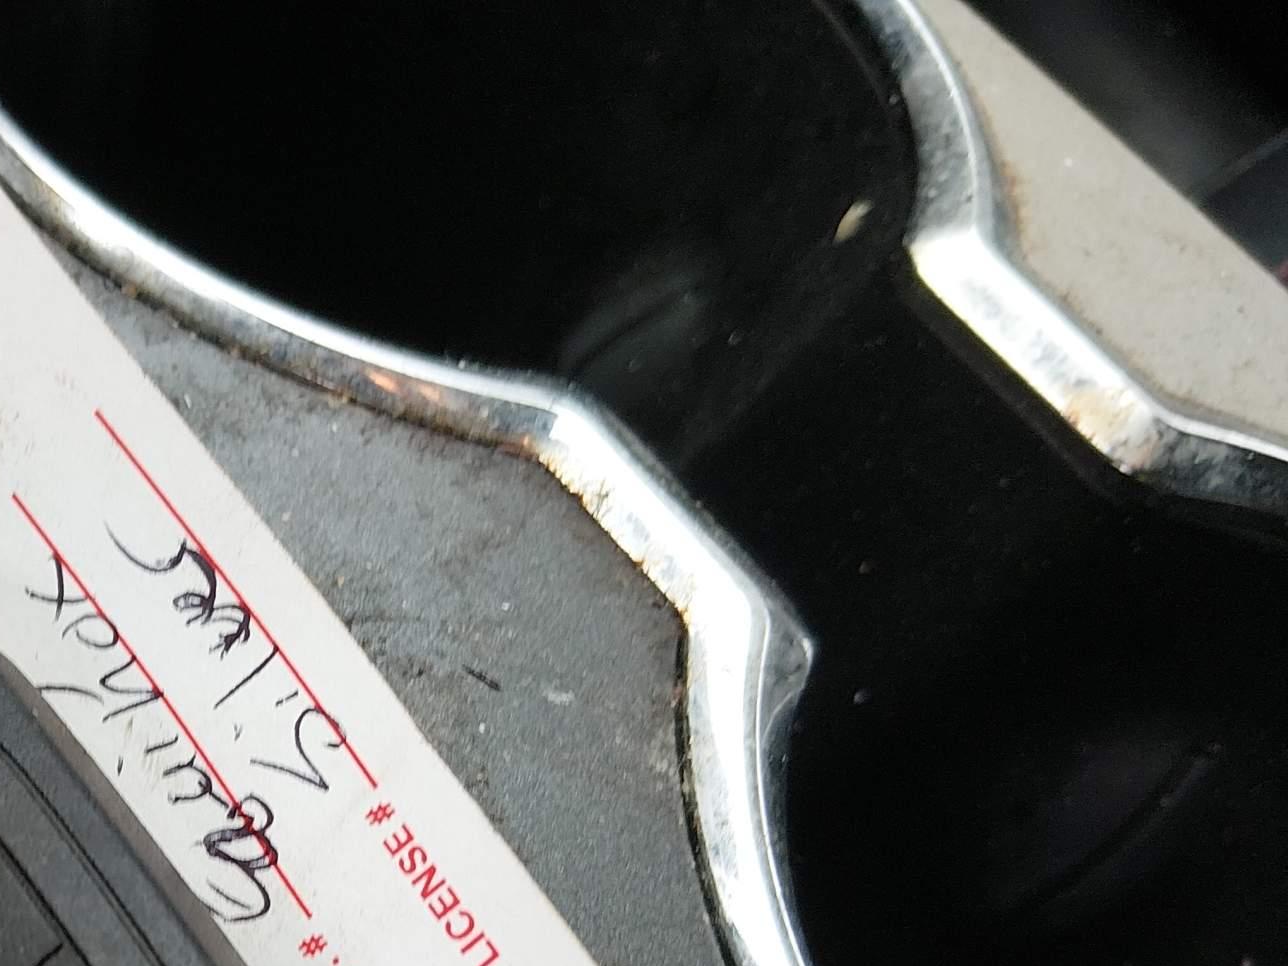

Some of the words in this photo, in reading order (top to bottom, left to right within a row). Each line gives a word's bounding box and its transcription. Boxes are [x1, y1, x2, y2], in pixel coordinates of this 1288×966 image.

[105, 521, 347, 791] Silver
[365, 801, 395, 827] #
[298, 932, 328, 960] #
